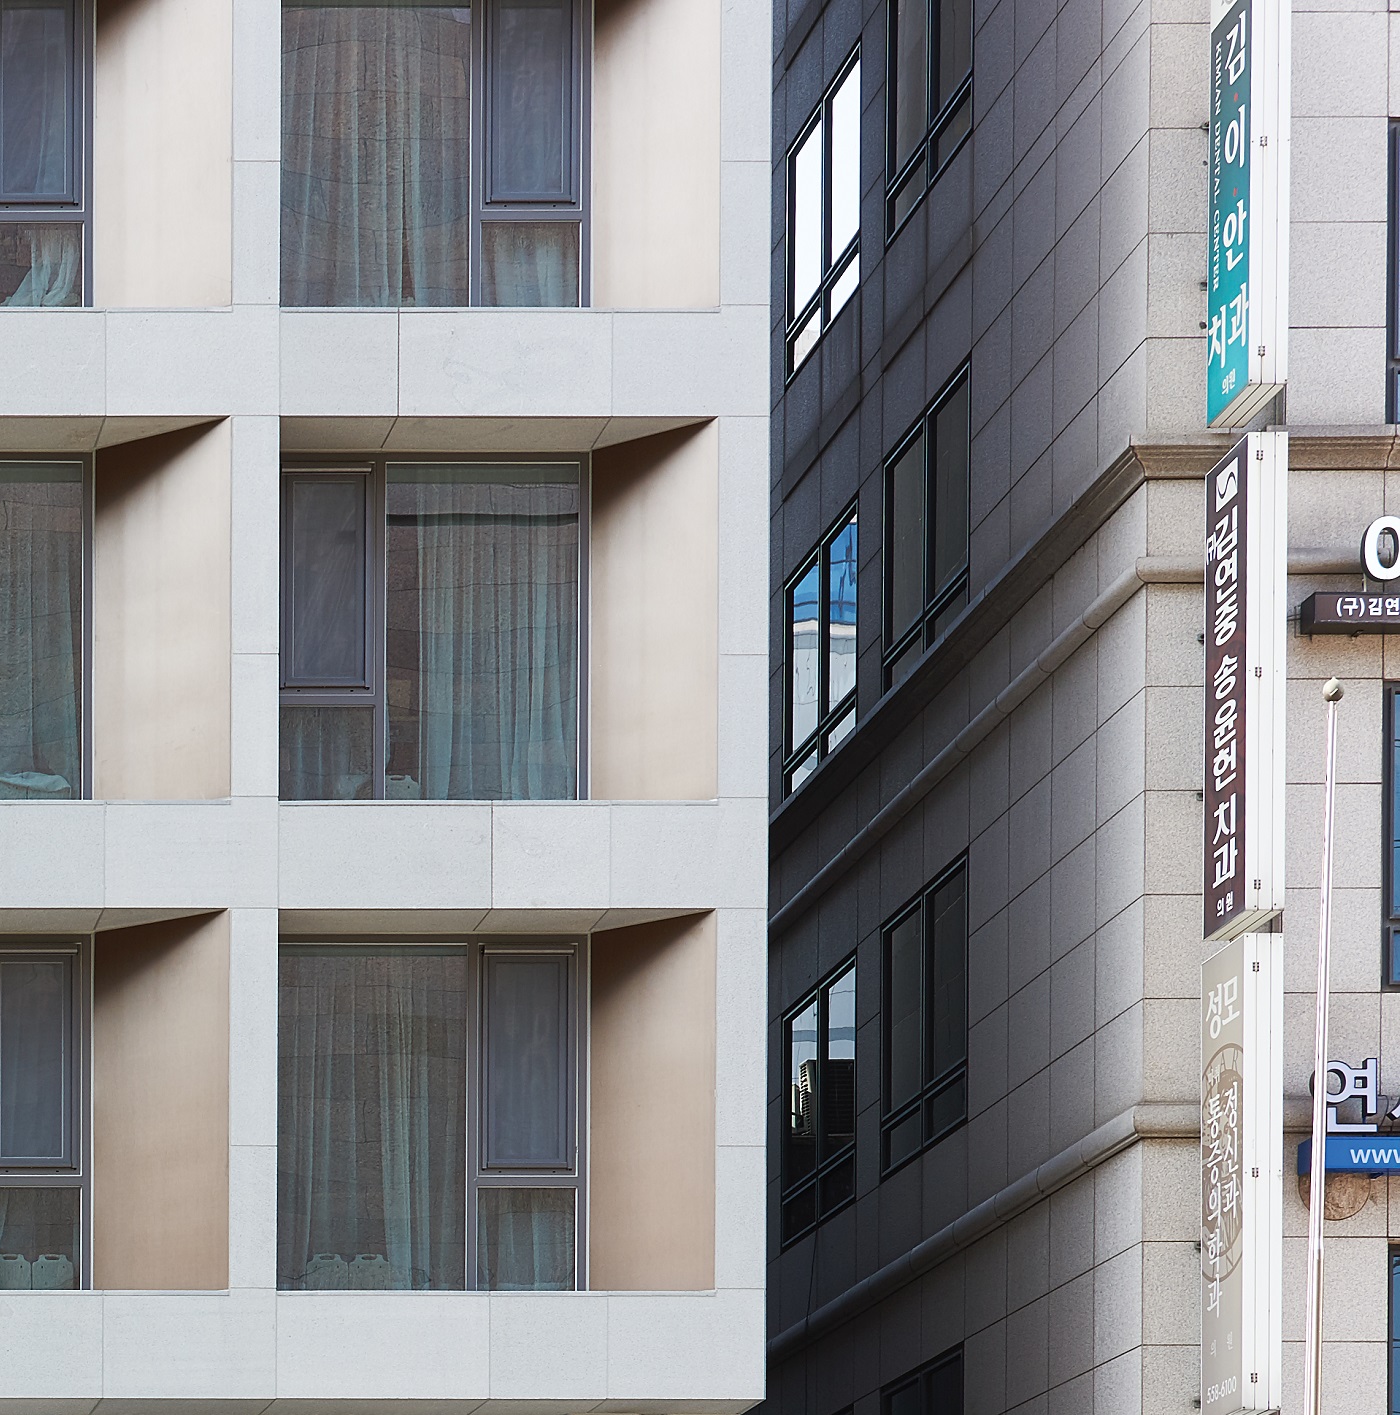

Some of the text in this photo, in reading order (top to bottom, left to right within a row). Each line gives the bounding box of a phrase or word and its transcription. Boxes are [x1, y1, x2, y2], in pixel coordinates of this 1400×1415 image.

[1213, 654, 1238, 792] 송윤헌
[1213, 792, 1238, 889] 치과
[1216, 891, 1234, 917] 의원
[1206, 975, 1240, 1039] 성모
[1223, 1081, 1240, 1219] 정신과
[1206, 1375, 1237, 1405] 558-6100
